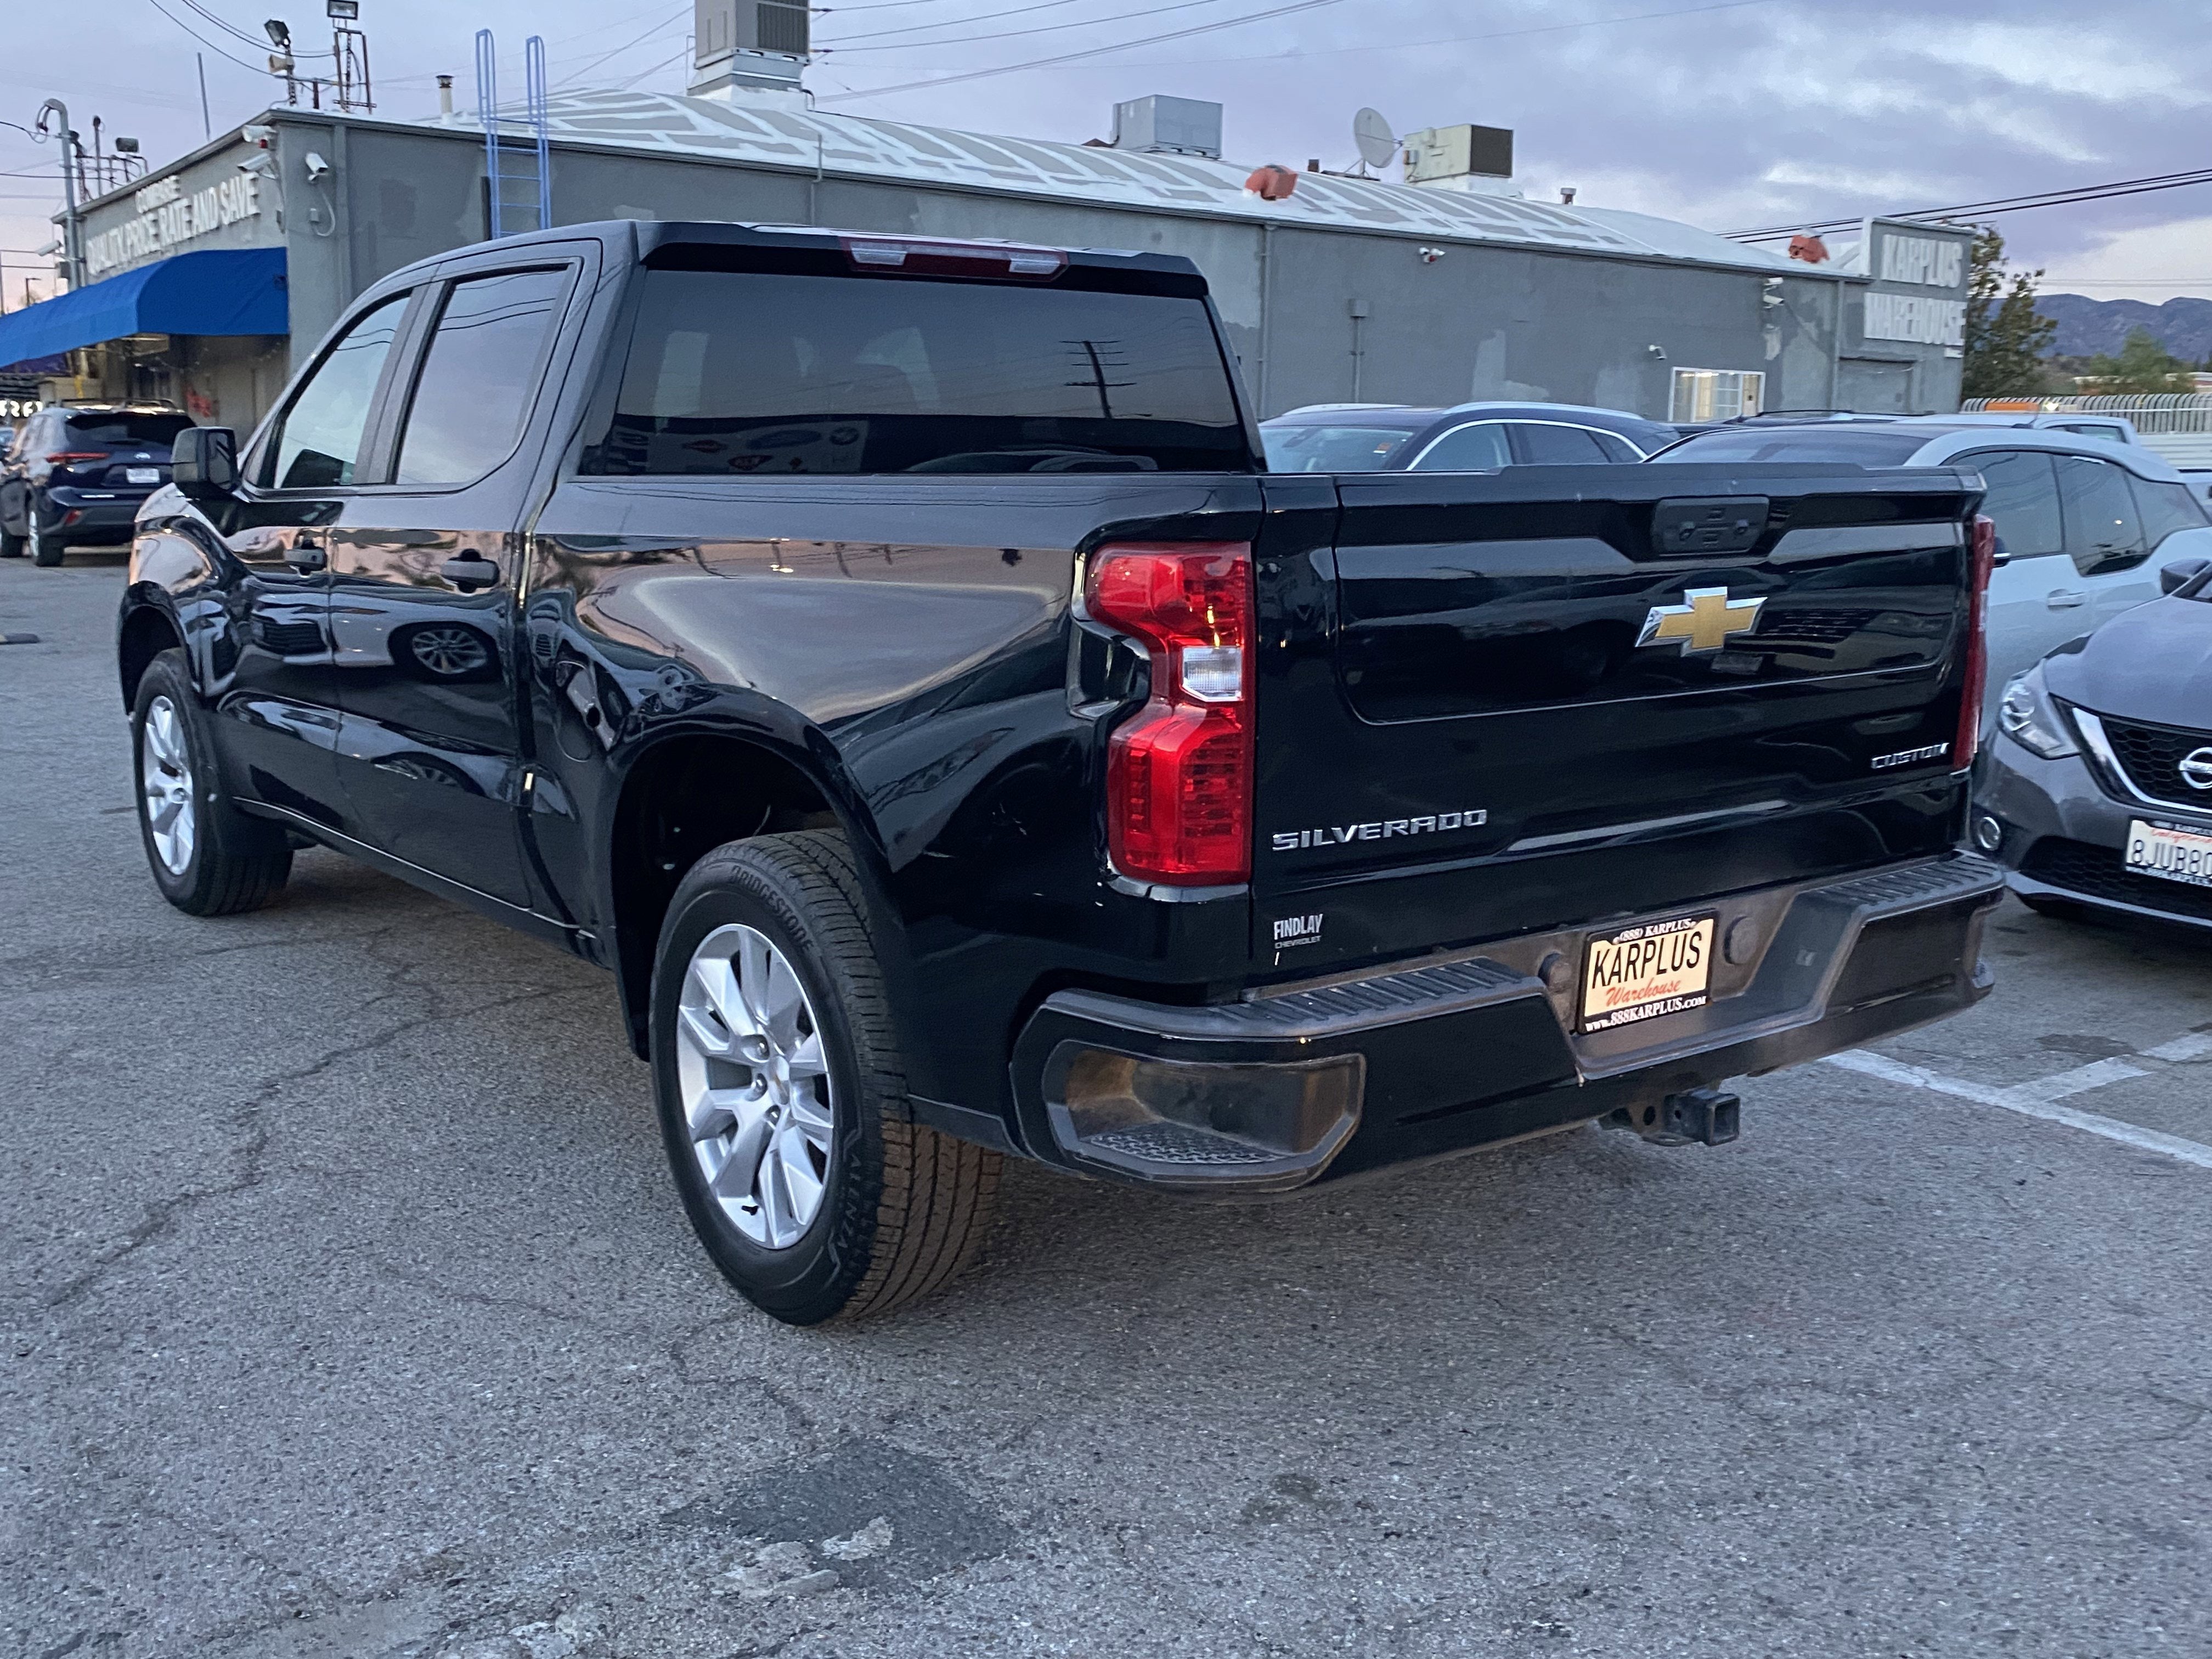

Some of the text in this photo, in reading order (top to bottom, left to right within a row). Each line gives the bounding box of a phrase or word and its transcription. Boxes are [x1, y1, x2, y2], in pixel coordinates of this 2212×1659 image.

[193, 187, 218, 235] AND
[220, 172, 261, 225] SAVE
[1881, 234, 1963, 288] KARPLUS
[1864, 292, 1968, 346] WAREHOUSE
[1272, 809, 1487, 851] SILVERADO
[730, 864, 814, 951] BRIDGESTONE
[1273, 913, 1323, 940] FINDLAY
[1645, 918, 1691, 937] KARPLUS
[1275, 935, 1322, 949] CHEVROLET
[1592, 930, 1702, 989] KARPLUS
[1605, 977, 1682, 1007] Warehouse
